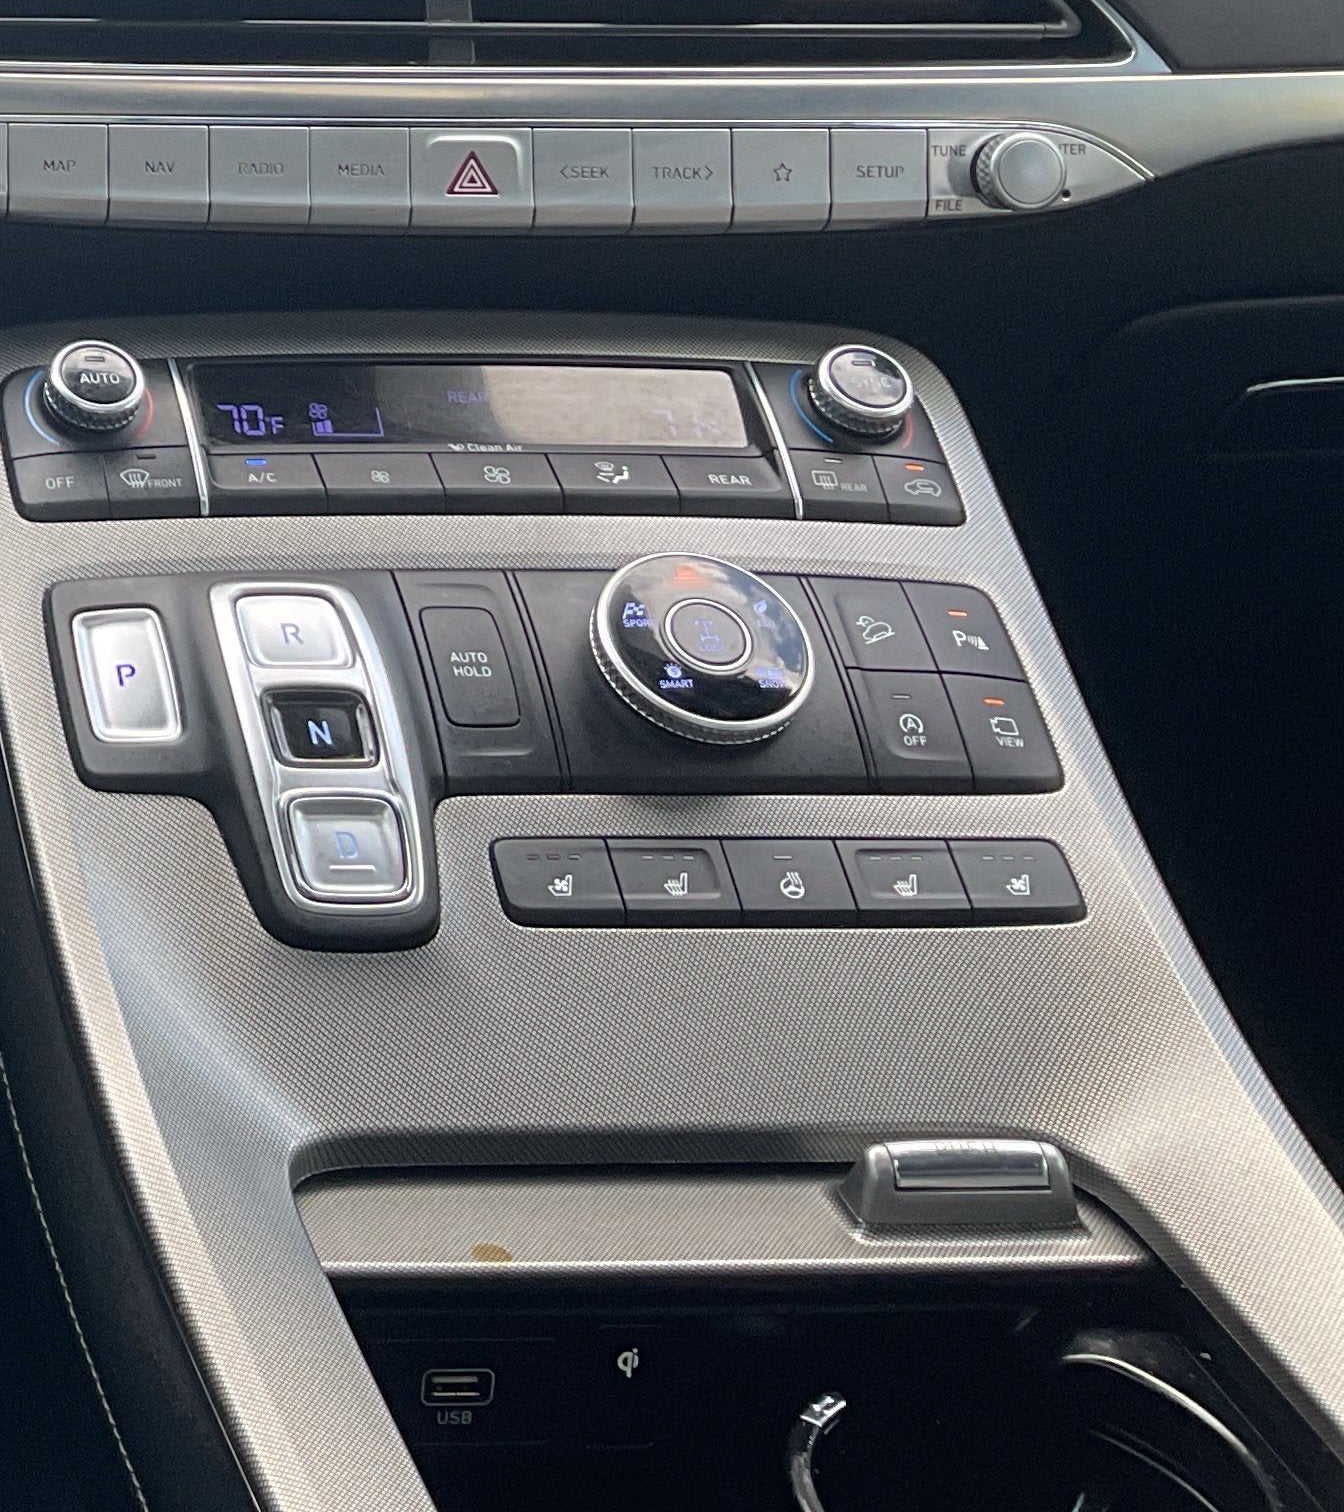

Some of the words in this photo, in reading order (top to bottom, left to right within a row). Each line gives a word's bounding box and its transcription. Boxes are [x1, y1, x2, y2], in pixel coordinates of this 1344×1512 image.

[931, 144, 967, 157] TUNE
[42, 159, 77, 172] MAP
[144, 160, 176, 174] NAV
[237, 161, 285, 176] RADIO
[337, 162, 385, 177] MEDIA
[856, 165, 905, 179] SETUP
[935, 199, 963, 212] FILE
[79, 371, 121, 385] AUTO
[467, 442, 503, 452] Clean
[505, 442, 524, 453] Air
[44, 475, 75, 490] OFF
[147, 478, 183, 489] FRONT
[247, 471, 278, 484] A/C
[707, 473, 753, 487] REAR
[280, 622, 305, 645] R
[450, 651, 489, 664] AUTO
[115, 663, 136, 687] P
[452, 664, 493, 678] HOLD
[658, 678, 695, 689] SMART
[307, 719, 334, 746] N
[902, 735, 928, 747] OFF
[995, 735, 1025, 748] VIEW
[334, 831, 360, 860] D
[436, 1410, 473, 1425] USB
